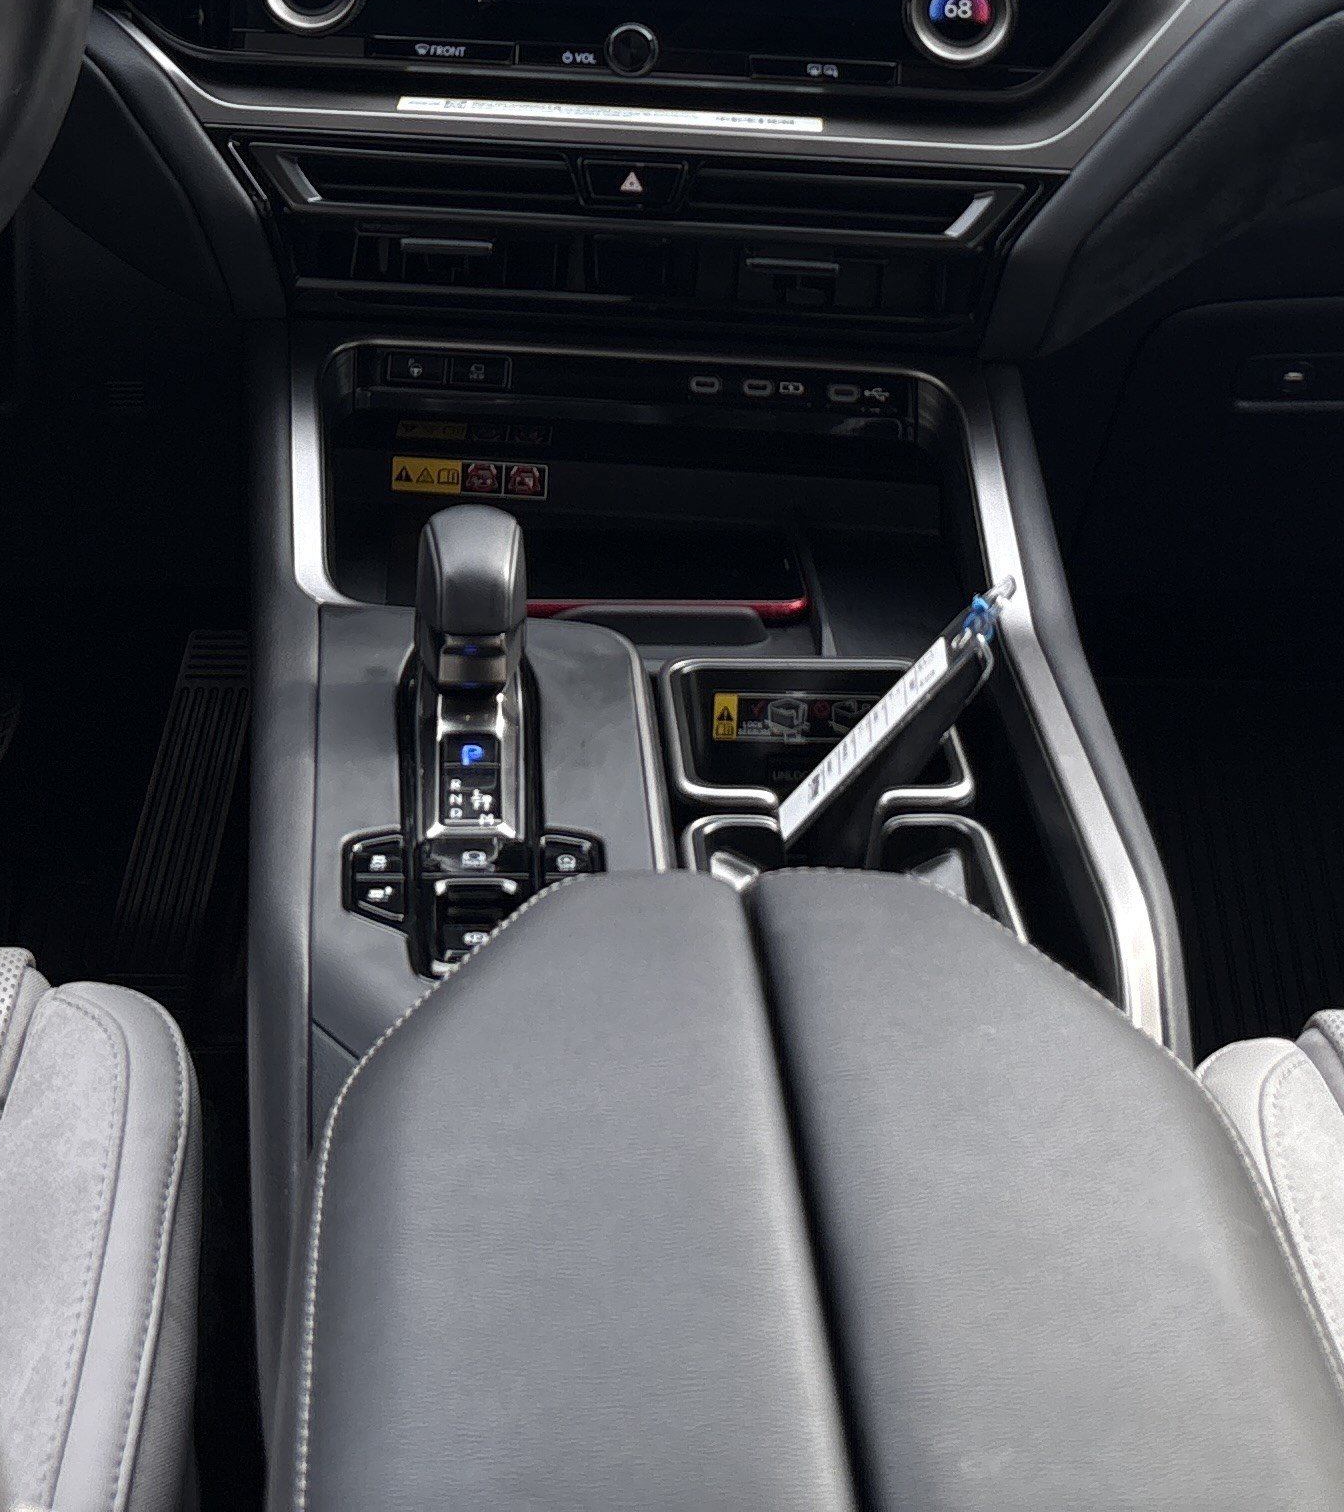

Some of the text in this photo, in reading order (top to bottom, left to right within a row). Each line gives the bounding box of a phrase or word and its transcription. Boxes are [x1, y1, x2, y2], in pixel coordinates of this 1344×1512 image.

[430, 45, 466, 57] FRONT
[574, 52, 597, 64] VOL
[461, 744, 485, 766] P
[450, 778, 461, 790] R
[450, 793, 462, 806] N
[450, 808, 462, 819] D
[479, 813, 494, 825] M
